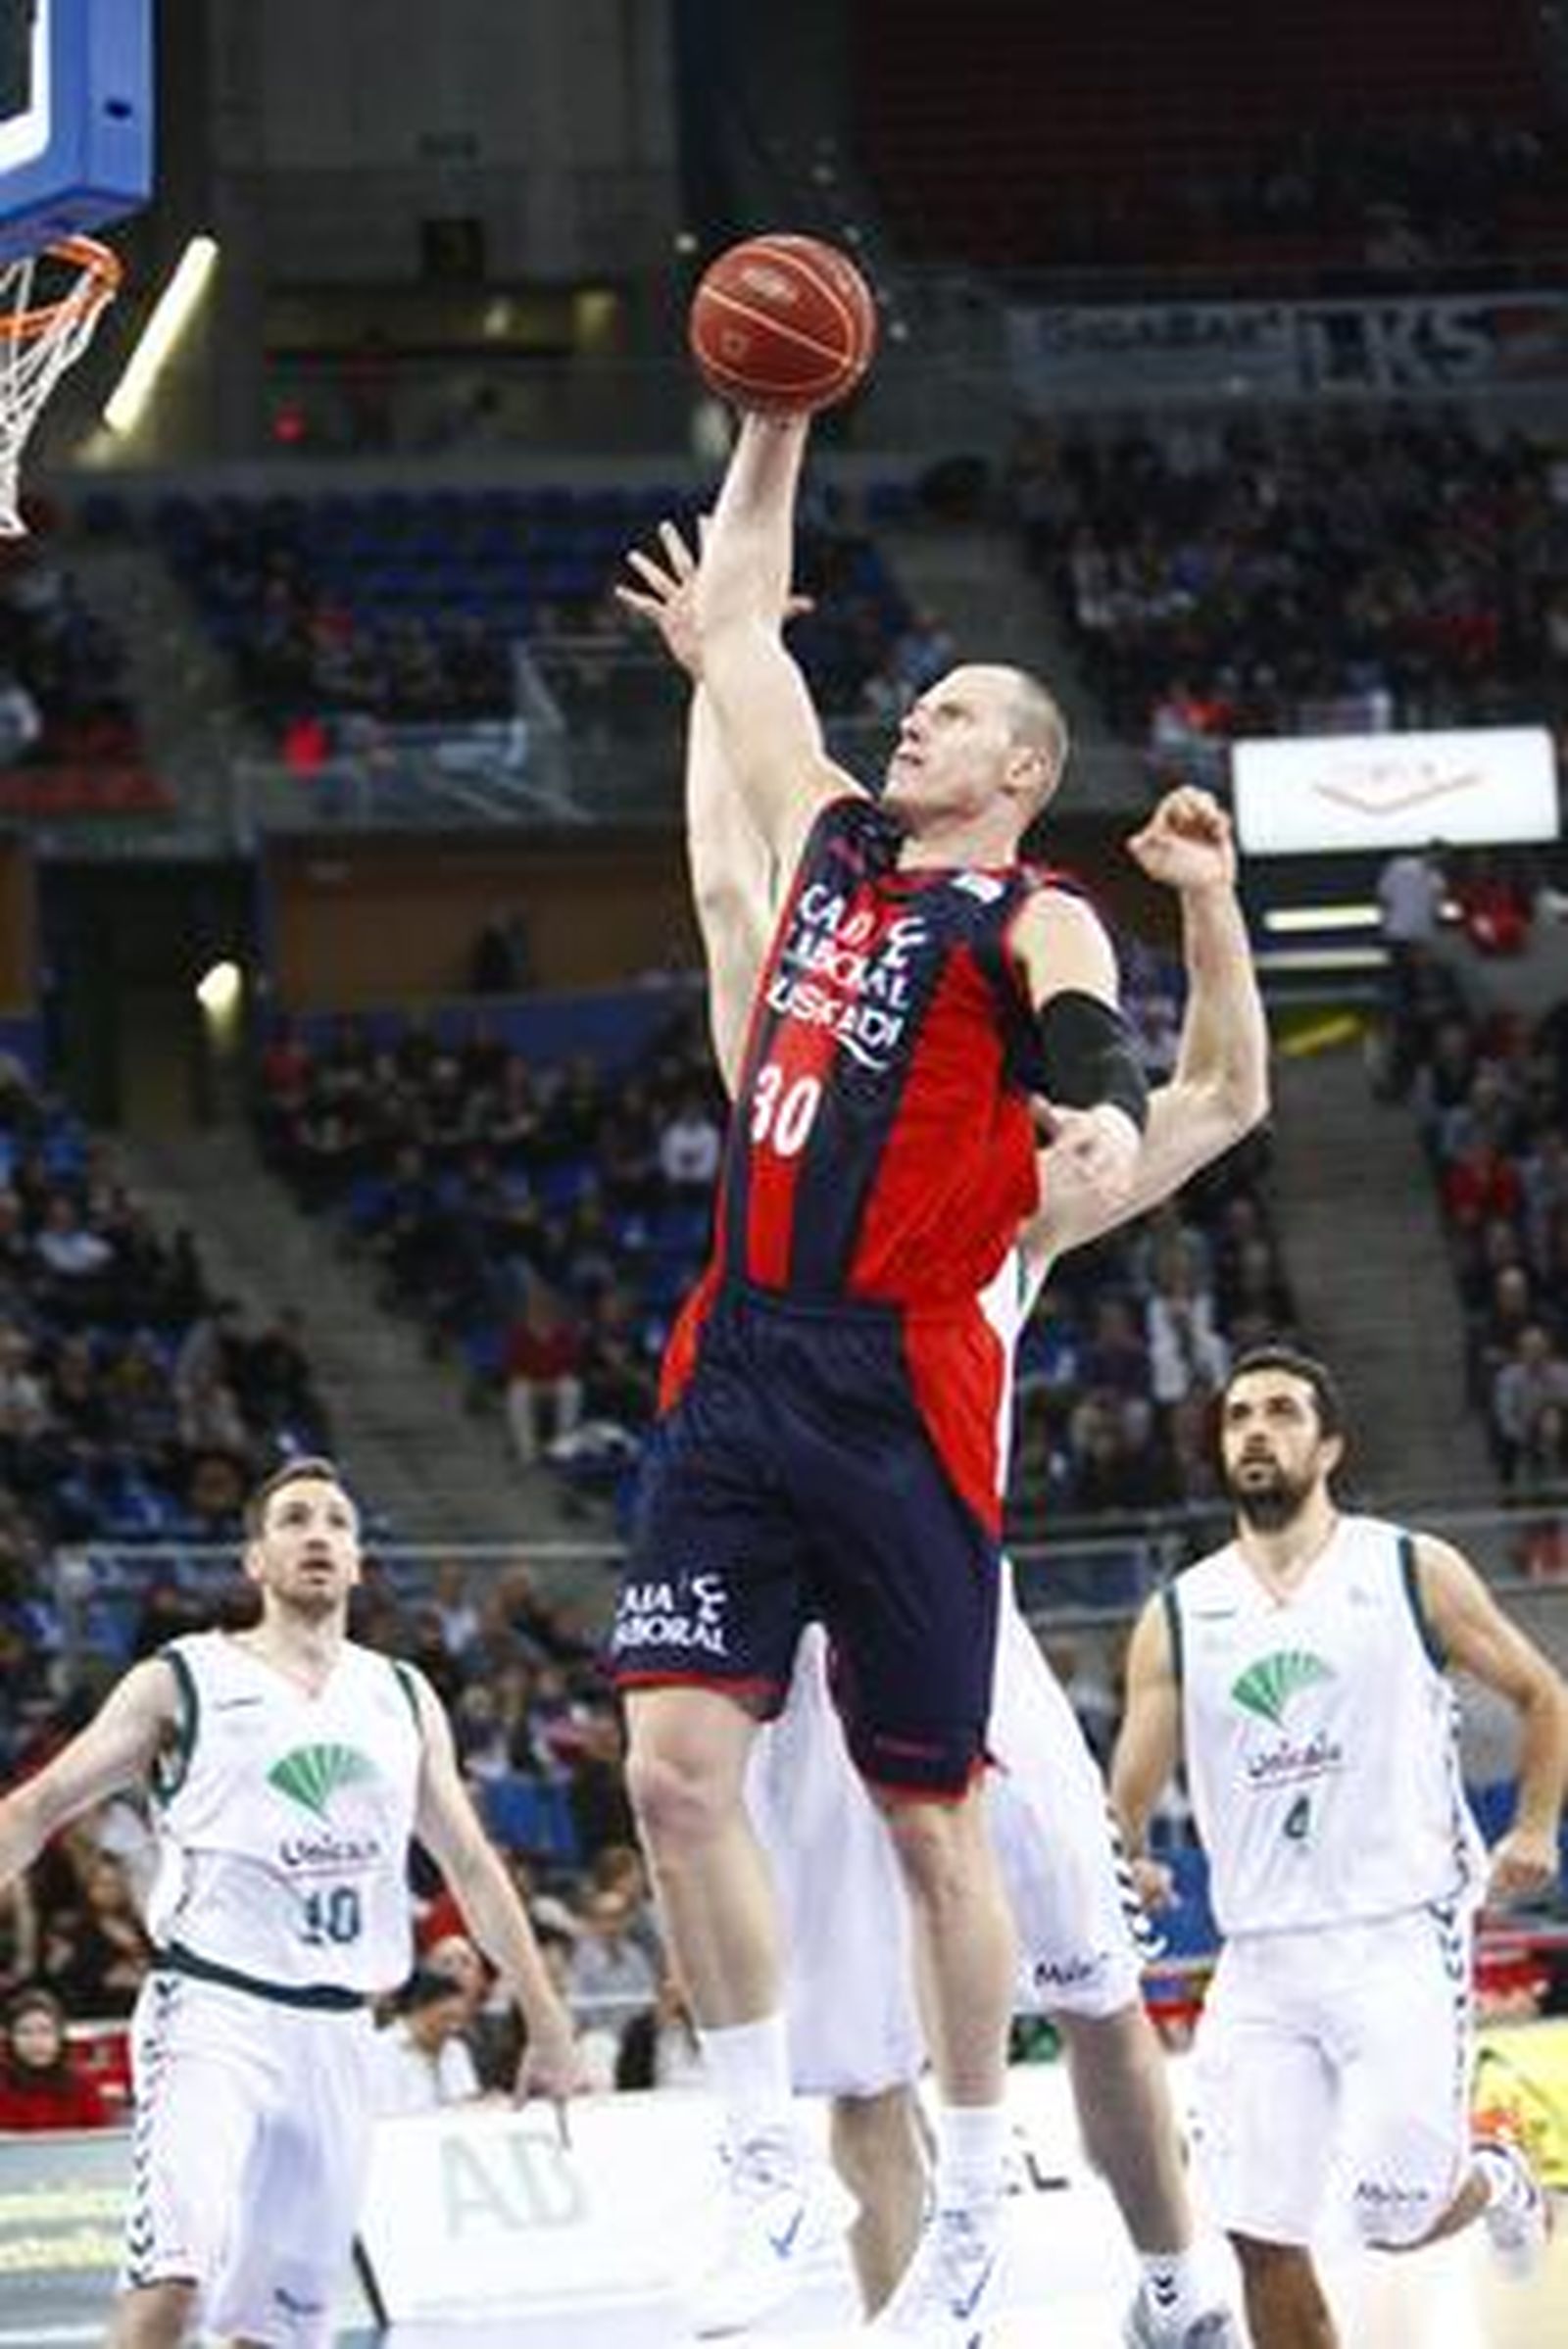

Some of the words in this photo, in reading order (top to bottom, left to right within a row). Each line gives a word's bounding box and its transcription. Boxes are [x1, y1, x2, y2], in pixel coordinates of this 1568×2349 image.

[766, 977, 904, 1047] USKADI
[752, 1064, 821, 1156] 30
[297, 1885, 361, 1944] 10
